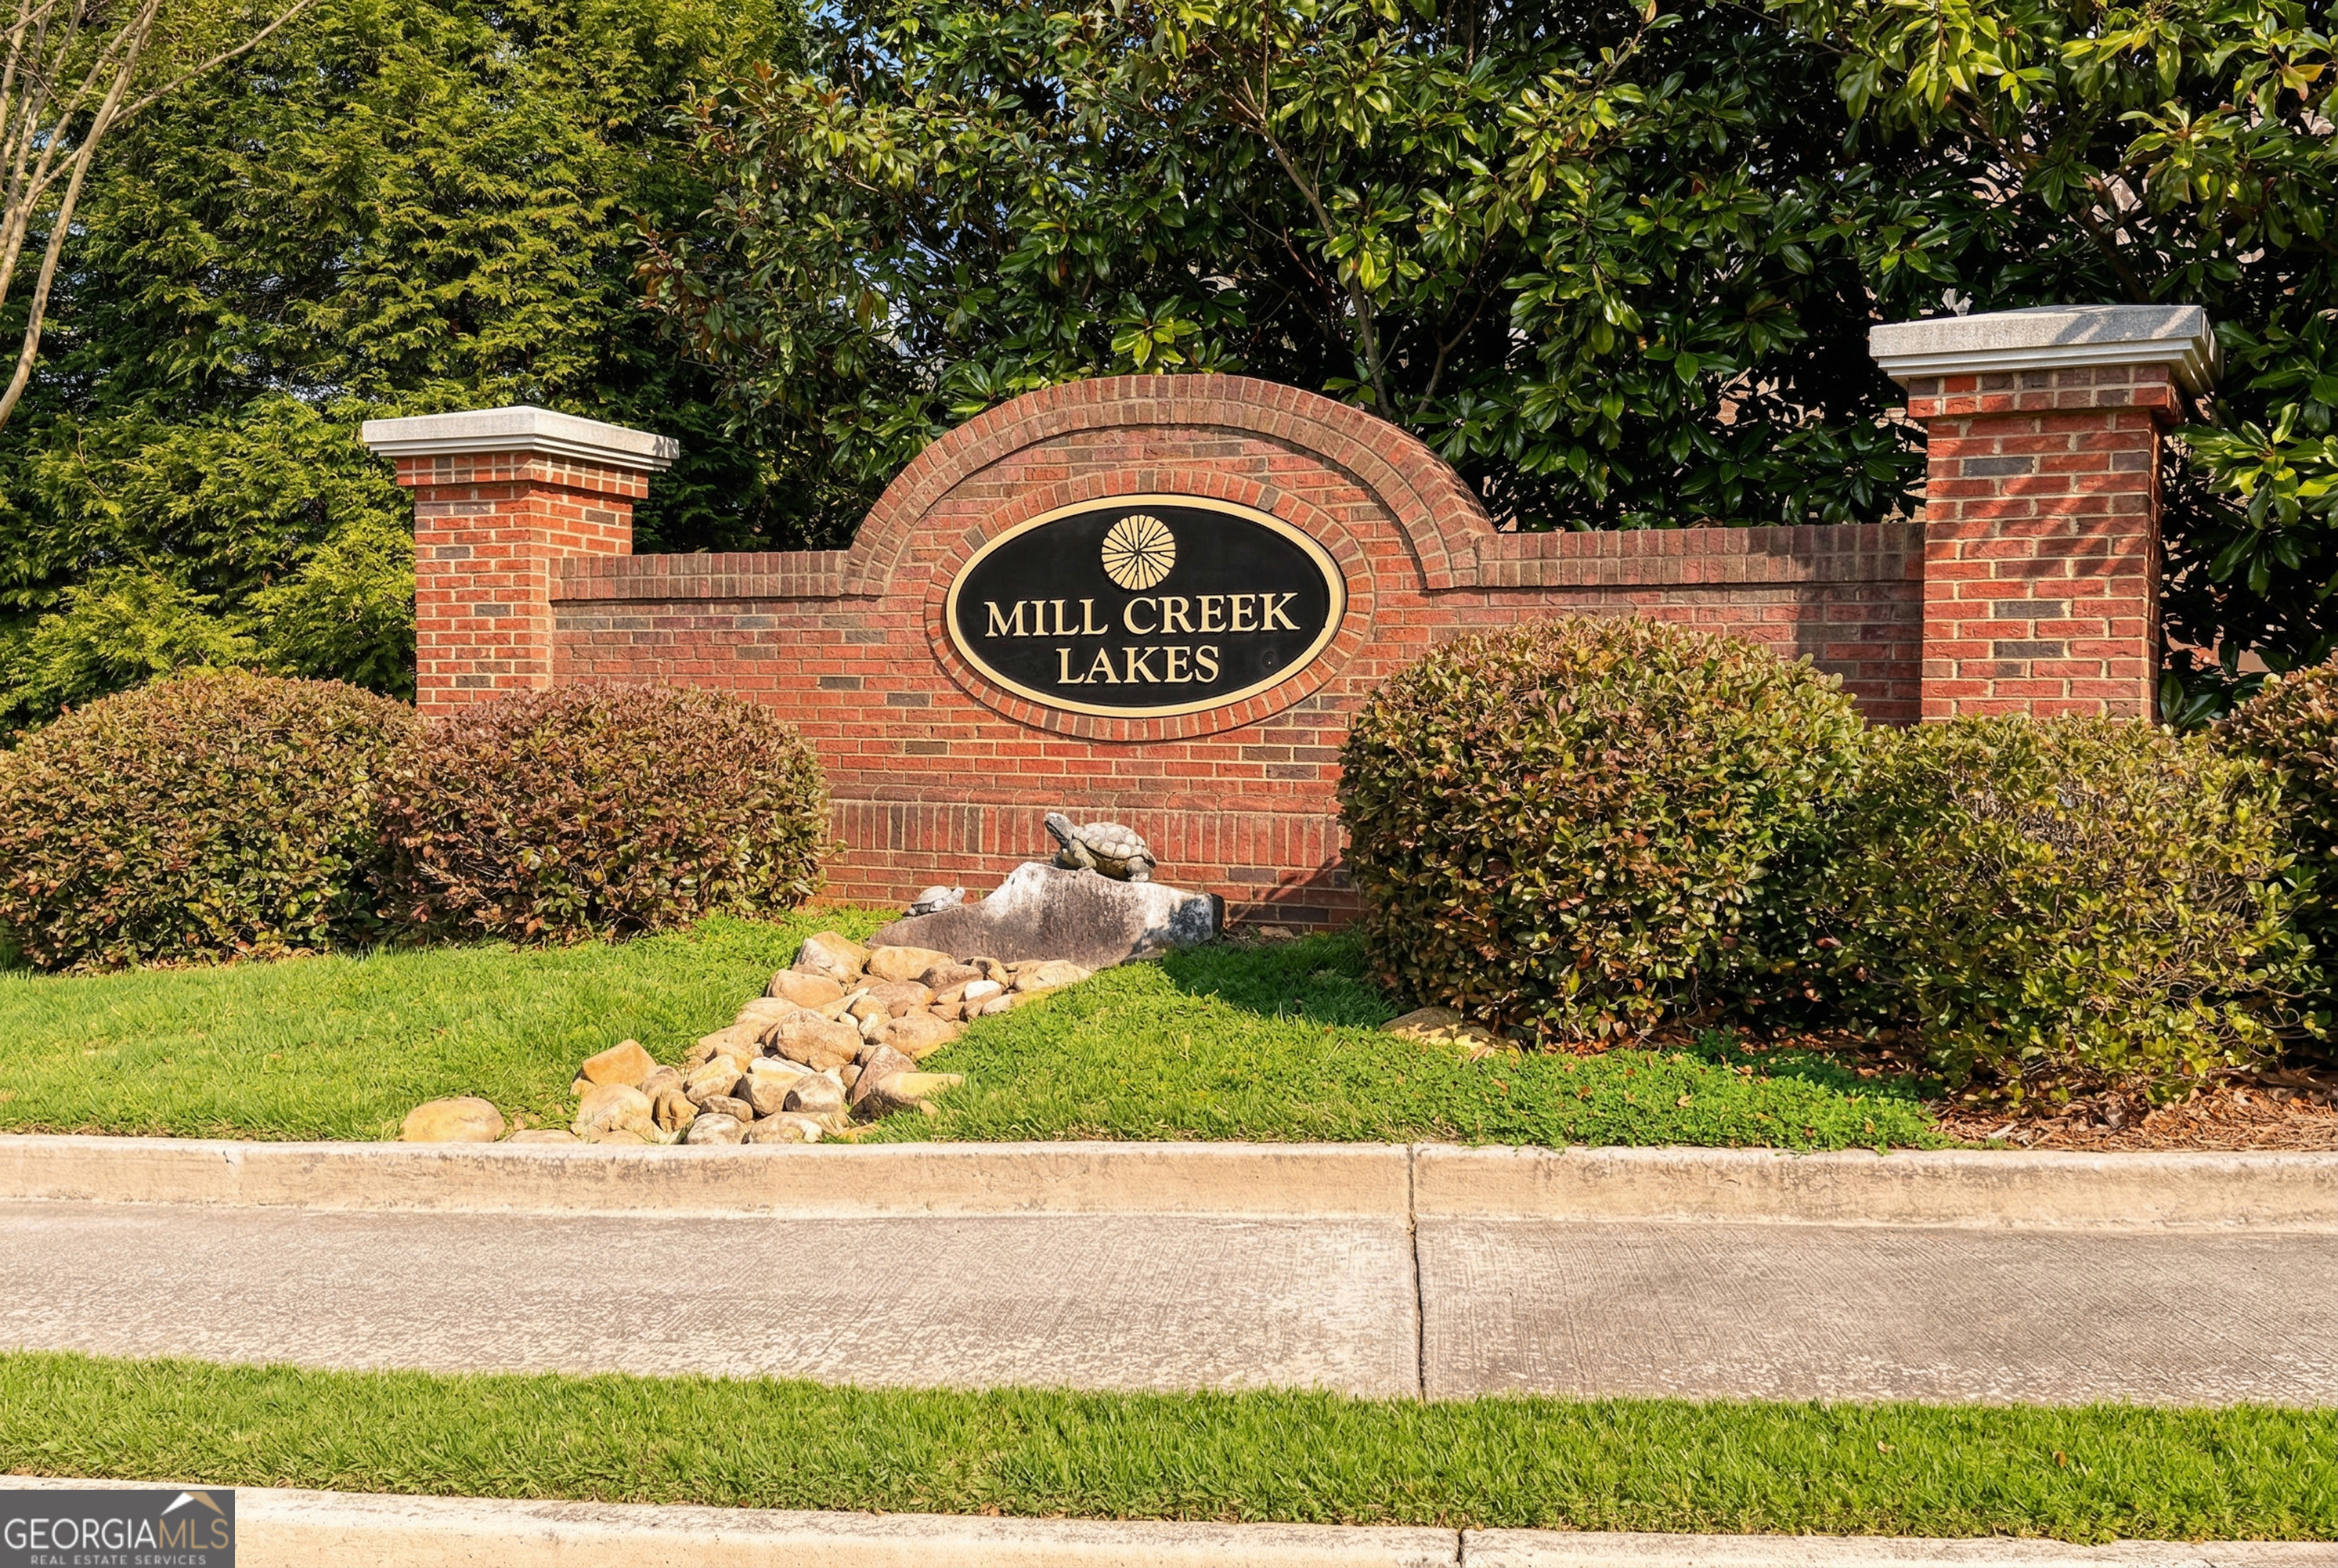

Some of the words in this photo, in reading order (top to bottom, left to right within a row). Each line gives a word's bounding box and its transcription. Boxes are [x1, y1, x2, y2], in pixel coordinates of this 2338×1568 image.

[983, 598, 1109, 637] MILL
[1123, 593, 1301, 635] CREEK
[1055, 645, 1220, 683] LAKES
